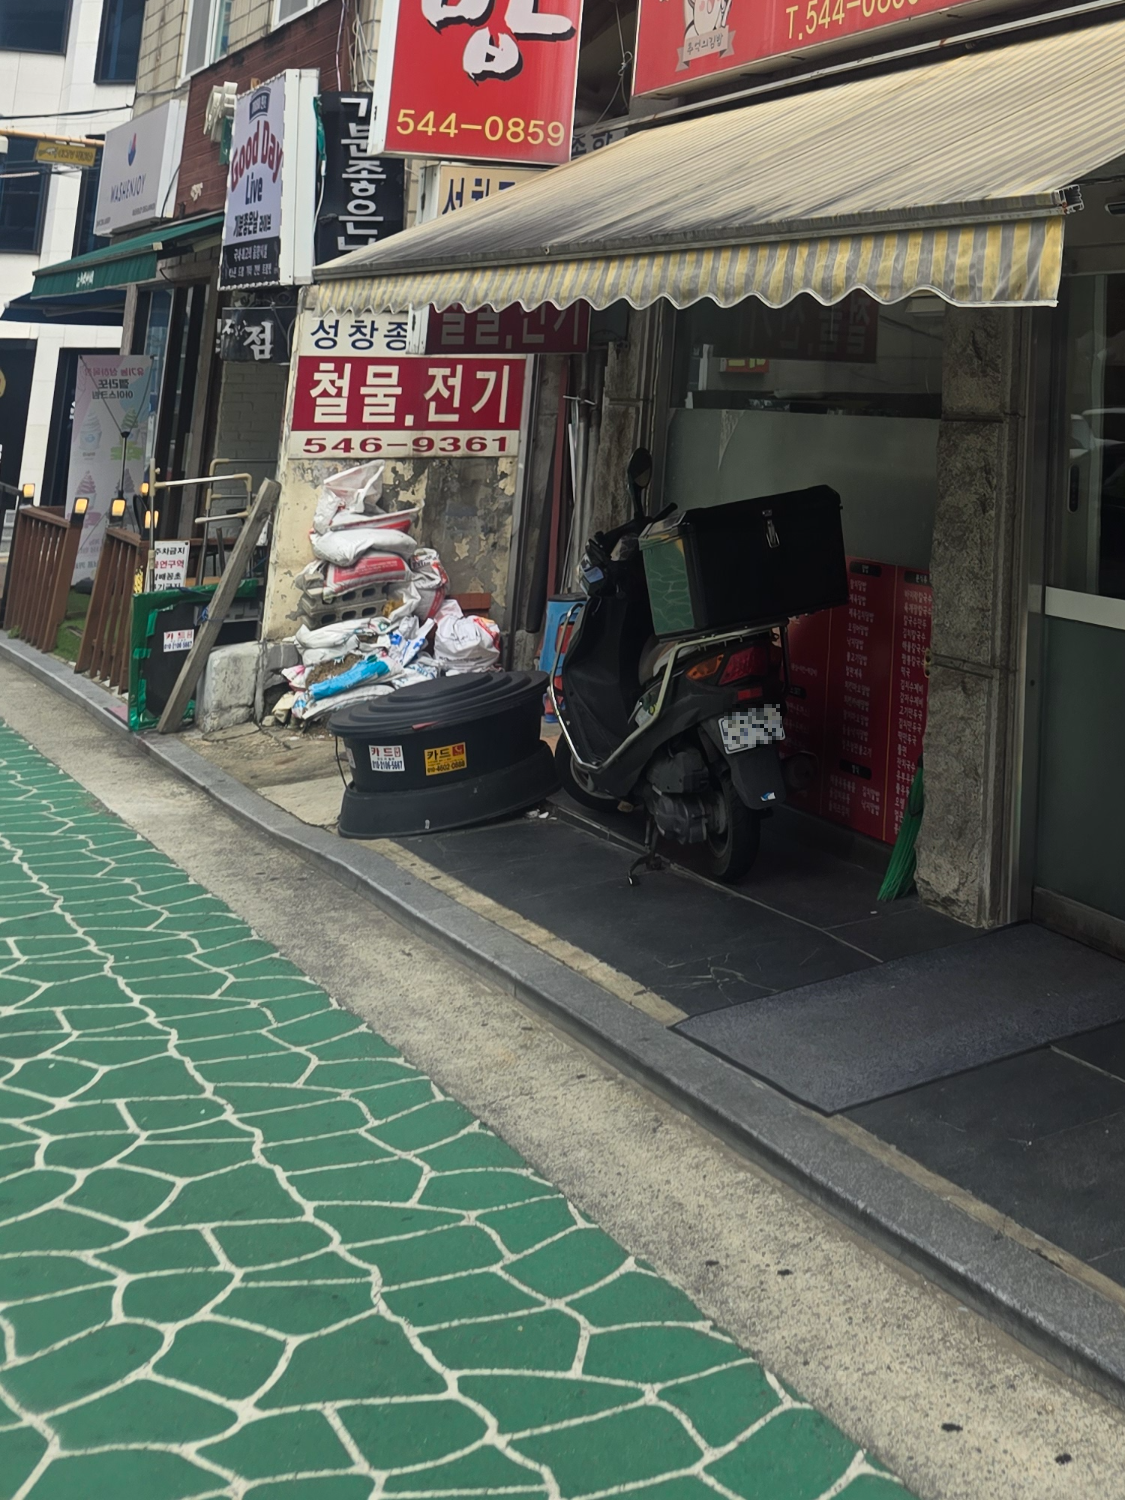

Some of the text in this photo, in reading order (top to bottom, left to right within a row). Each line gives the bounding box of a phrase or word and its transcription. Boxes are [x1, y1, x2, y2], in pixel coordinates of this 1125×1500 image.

[395, 109, 566, 148] 544-0859
[231, 120, 284, 193] Good Day
[110, 173, 147, 203] WASHENJOY
[245, 172, 264, 205] Live
[308, 362, 513, 428] 철물.전기
[302, 436, 510, 455] 546-9361
